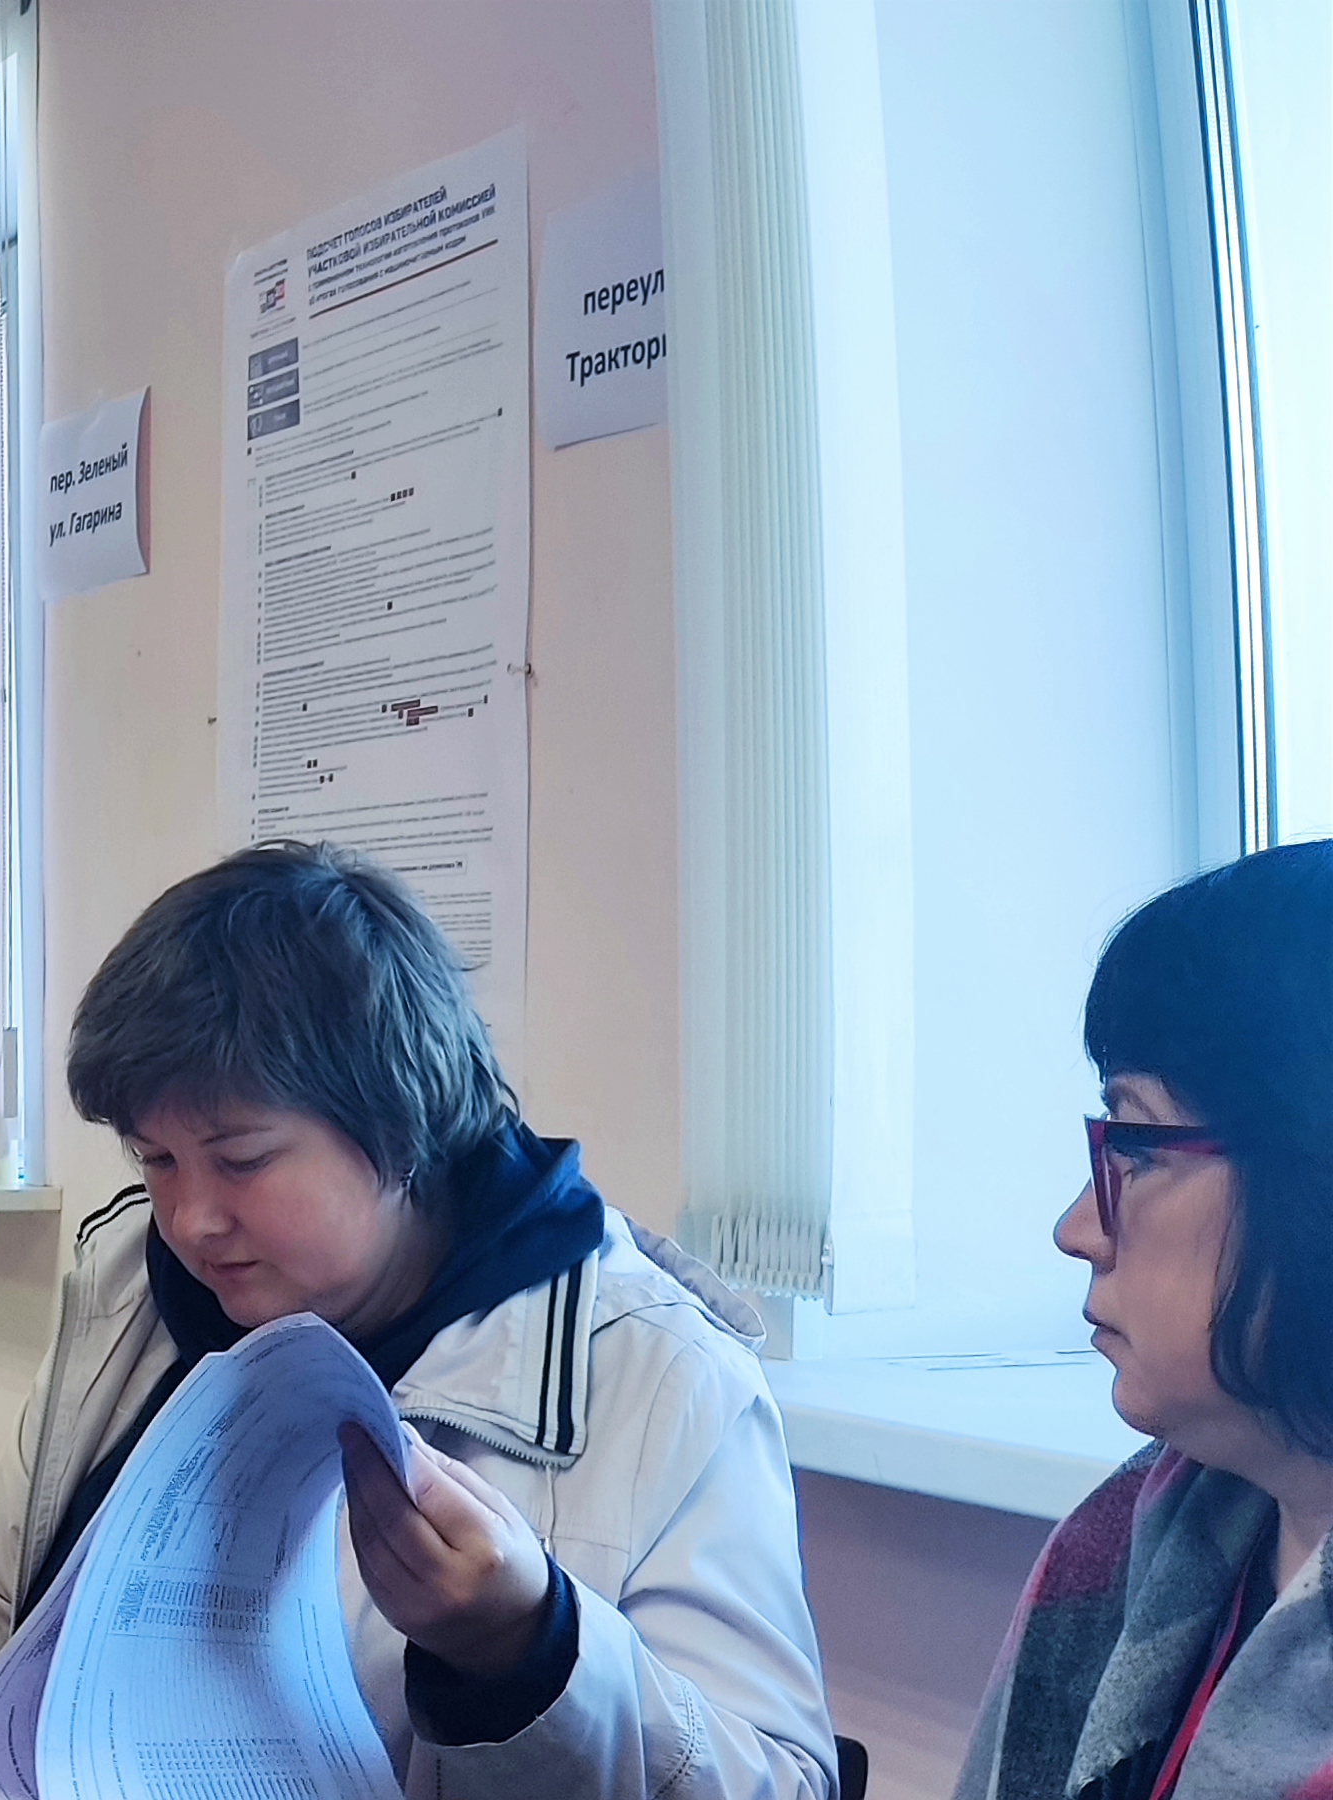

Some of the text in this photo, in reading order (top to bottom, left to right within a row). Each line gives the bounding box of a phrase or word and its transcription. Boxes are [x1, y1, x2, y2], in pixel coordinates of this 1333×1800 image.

[306, 185, 447, 260] ПОДСЧЕТ ГОЛОСОВ ИЗБИРАТЕЛЕЙ
[308, 240, 361, 277] УЧАСТКОВОЙ
[363, 211, 436, 257] ИЗБИРАТЕЛЬНОЙ
[438, 183, 495, 220] КОМИССИЕЙ
[583, 268, 665, 316] переул
[50, 442, 128, 494] пер. Зеленый
[49, 501, 123, 548] ул. Гагарина
